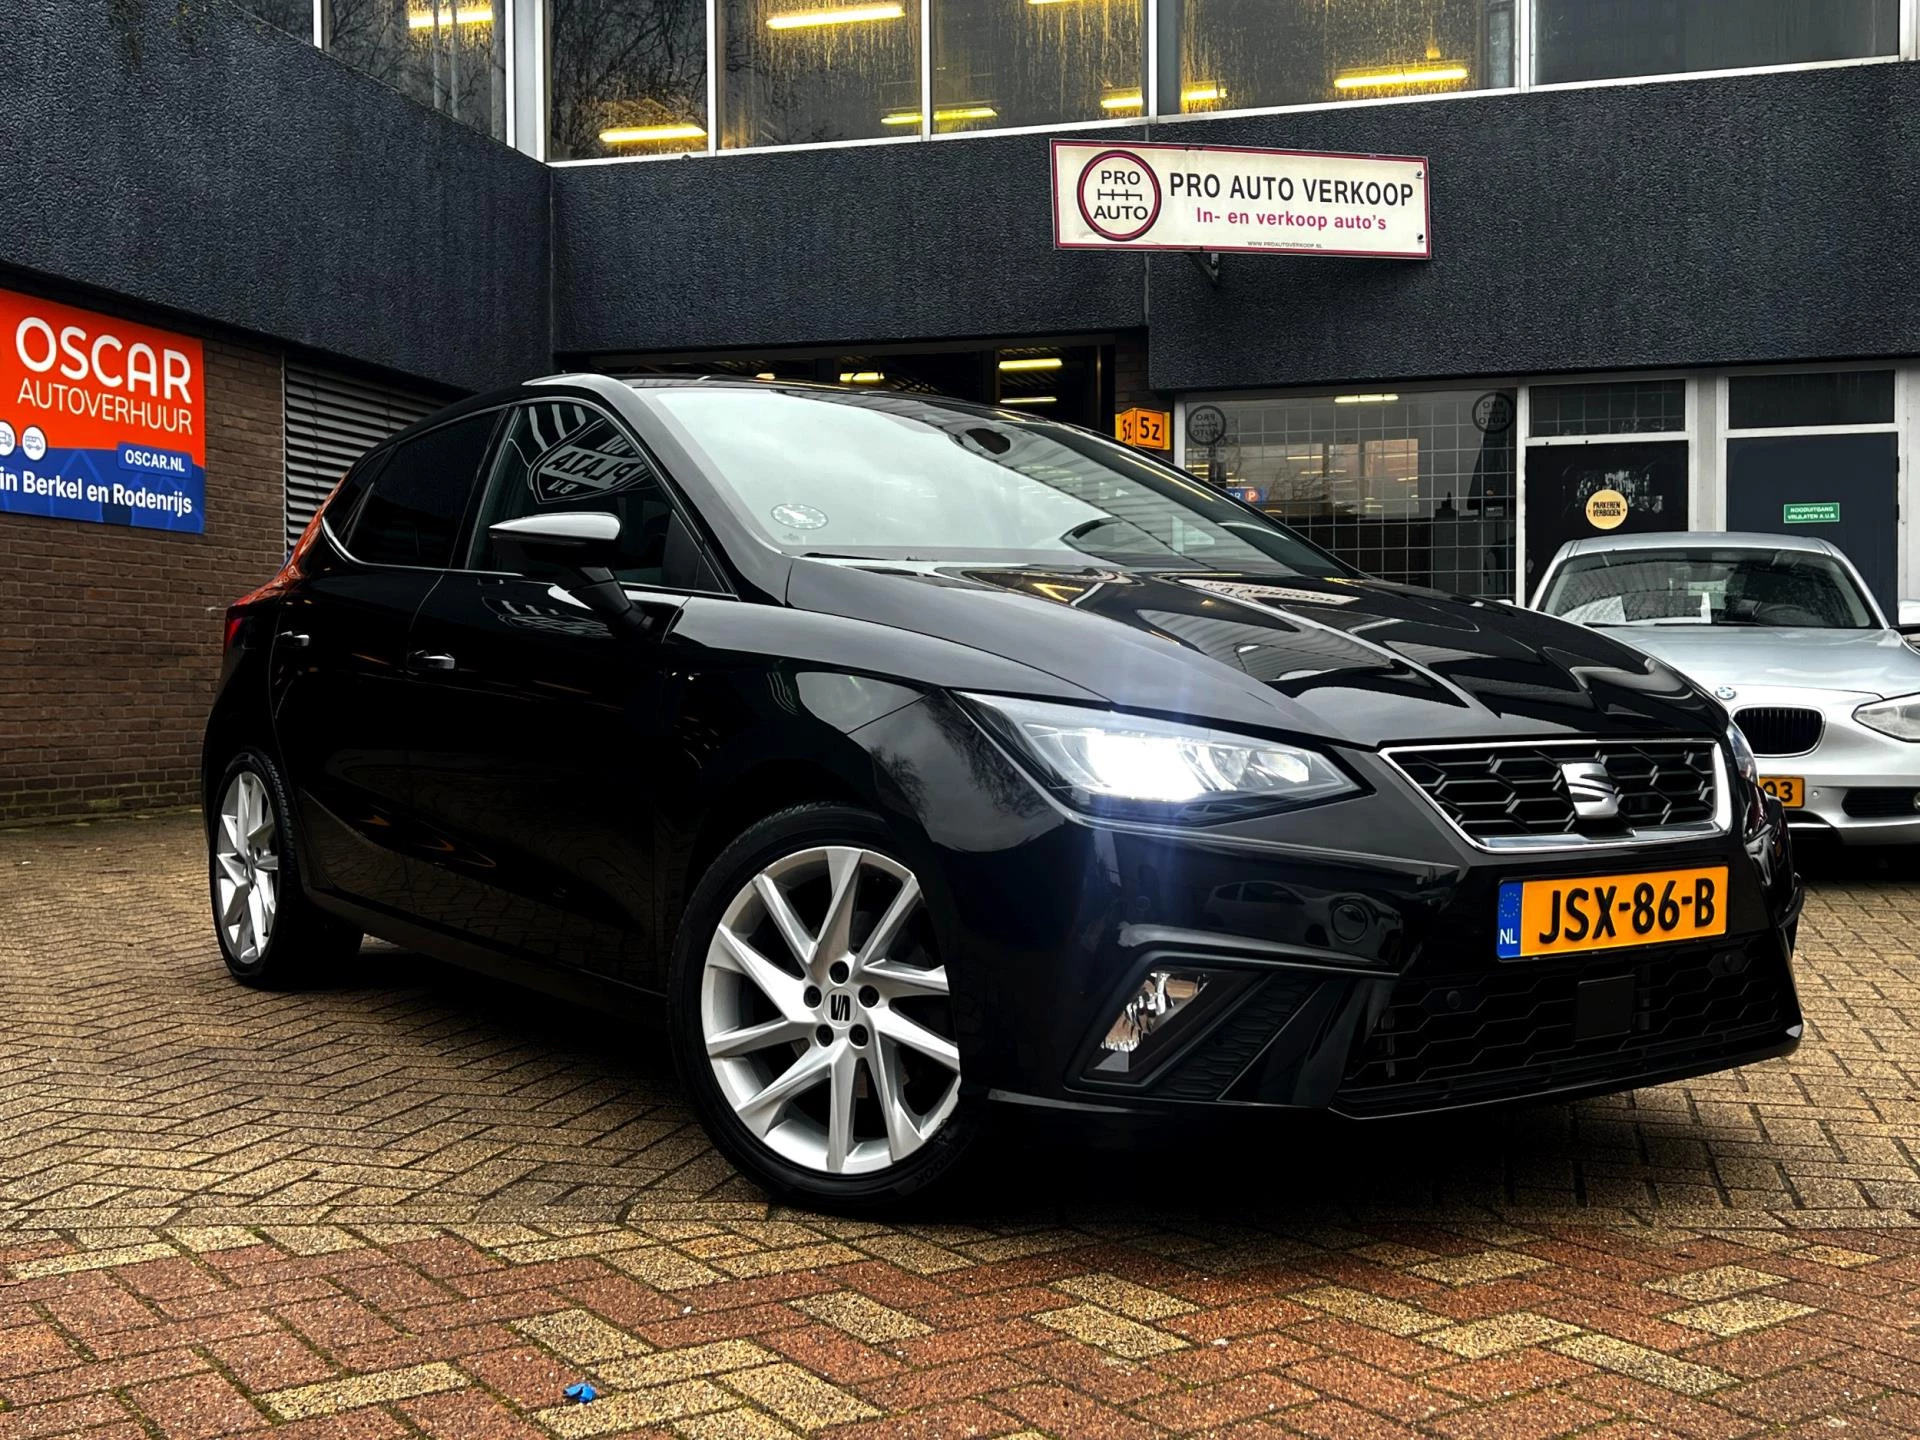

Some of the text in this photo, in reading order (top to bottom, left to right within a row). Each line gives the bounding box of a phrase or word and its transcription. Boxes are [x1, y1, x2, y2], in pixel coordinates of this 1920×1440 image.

[1101, 170, 1141, 186] PRO
[1169, 171, 1414, 207] PRO AUTO VERKOOP
[1093, 205, 1149, 221] AUTO
[1196, 206, 1387, 231] In- en verkoop auto's
[15, 316, 193, 404] OSCAR
[17, 377, 193, 436] AUTOVERHUUR
[124, 449, 186, 473] OSCAR.NL
[0, 466, 193, 518] in Berkel en Rodenrijs
[1539, 877, 1716, 945] JSX-86-B
[1499, 928, 1518, 945] NL
